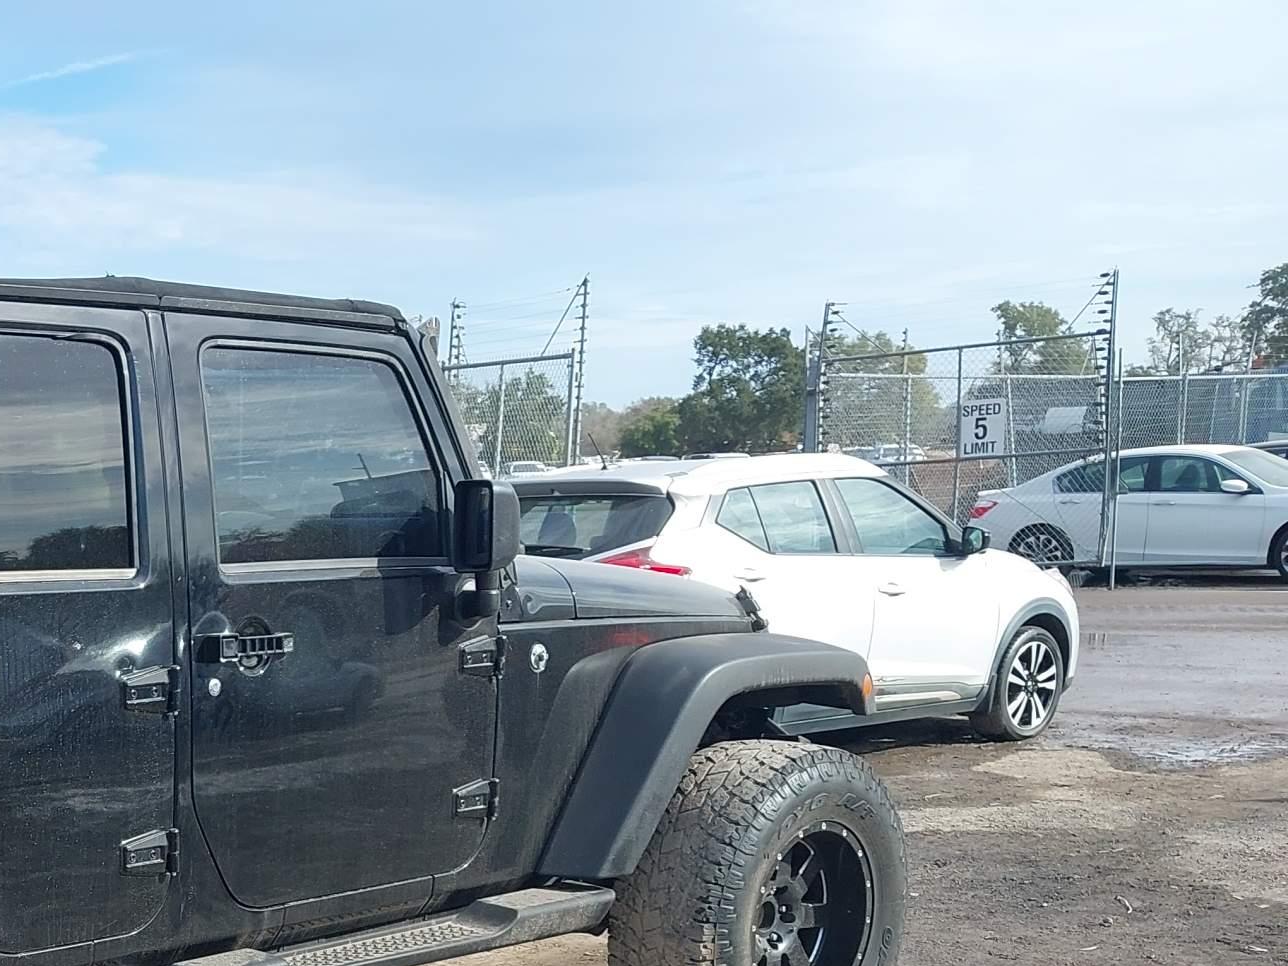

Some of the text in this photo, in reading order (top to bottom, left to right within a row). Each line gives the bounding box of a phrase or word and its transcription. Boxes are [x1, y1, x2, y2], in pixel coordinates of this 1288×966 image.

[962, 403, 1001, 417] SPEED
[974, 417, 988, 440] 5
[963, 441, 997, 455] LIMIT
